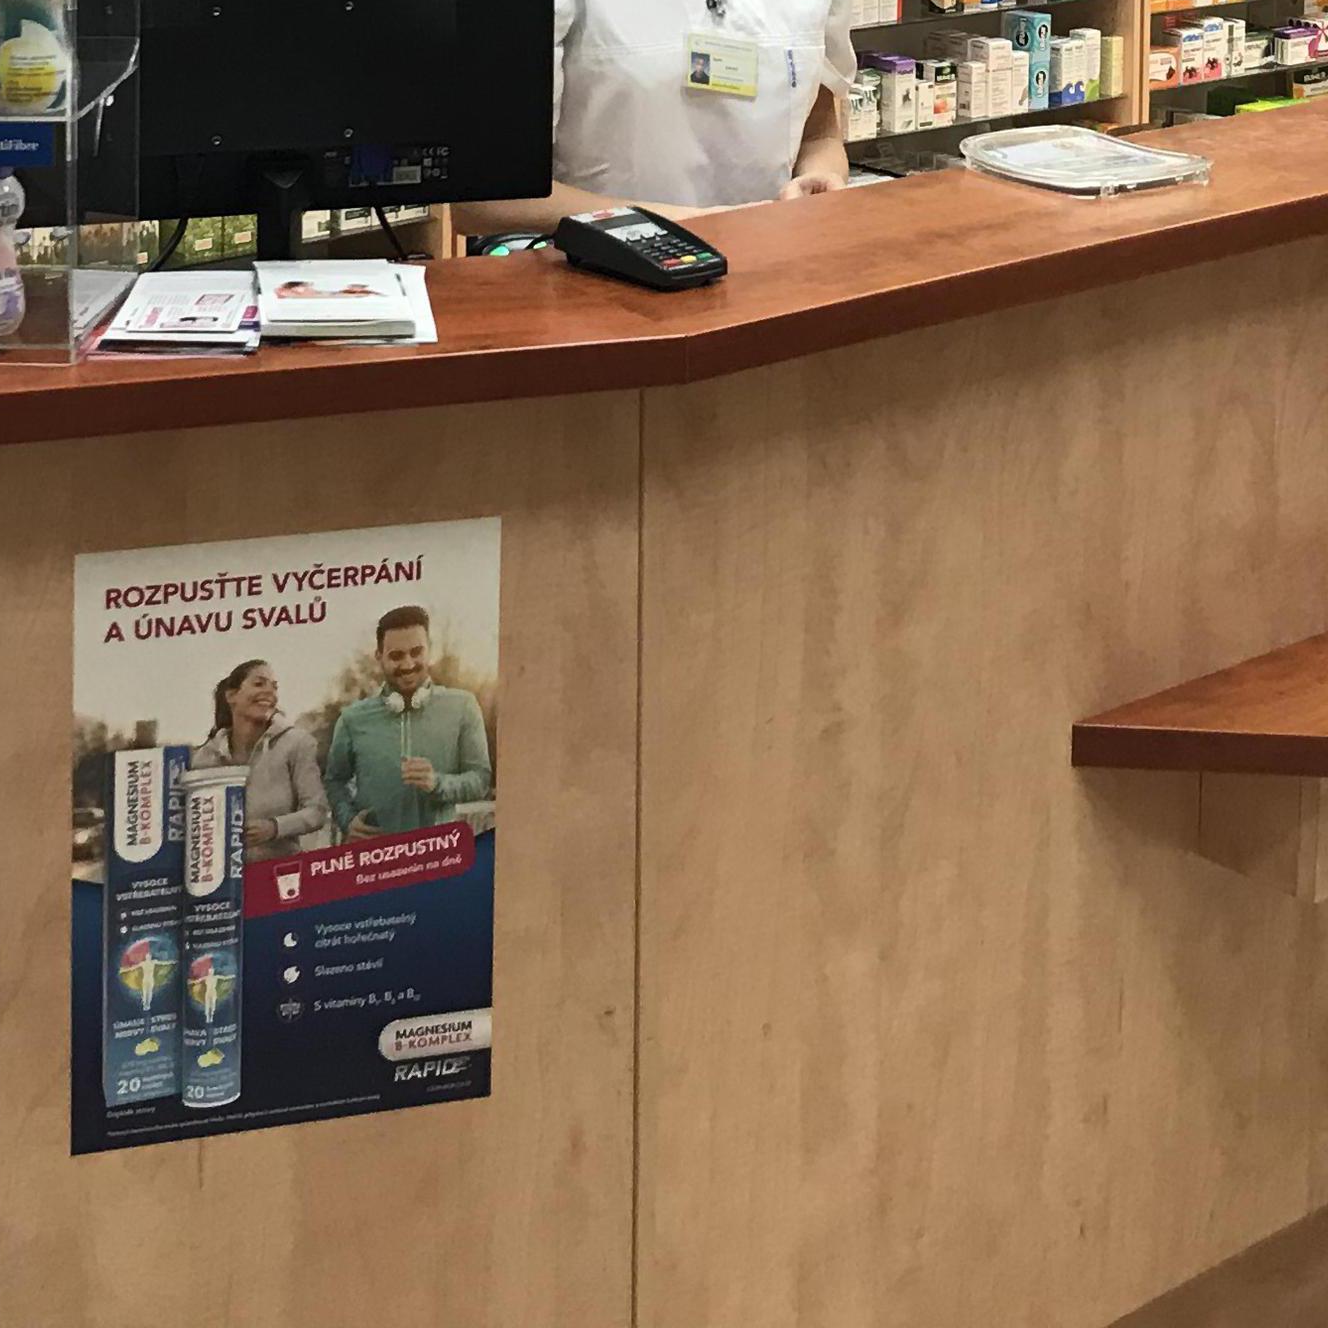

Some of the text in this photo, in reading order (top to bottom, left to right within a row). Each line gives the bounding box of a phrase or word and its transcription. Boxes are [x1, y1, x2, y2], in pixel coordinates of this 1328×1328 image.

[105, 555, 424, 610] ROZPUSŤTE VYČERPÁNÍ
[104, 597, 327, 643] A ÚNAVU SVALŮ
[128, 760, 139, 847] MAGNESIUM
[191, 796, 200, 884] MAGNESIUM
[311, 829, 461, 876] PLNĚ ROZPUSTNÝ
[395, 1020, 472, 1040] MAGNESIUM
[117, 1079, 141, 1095] 20
